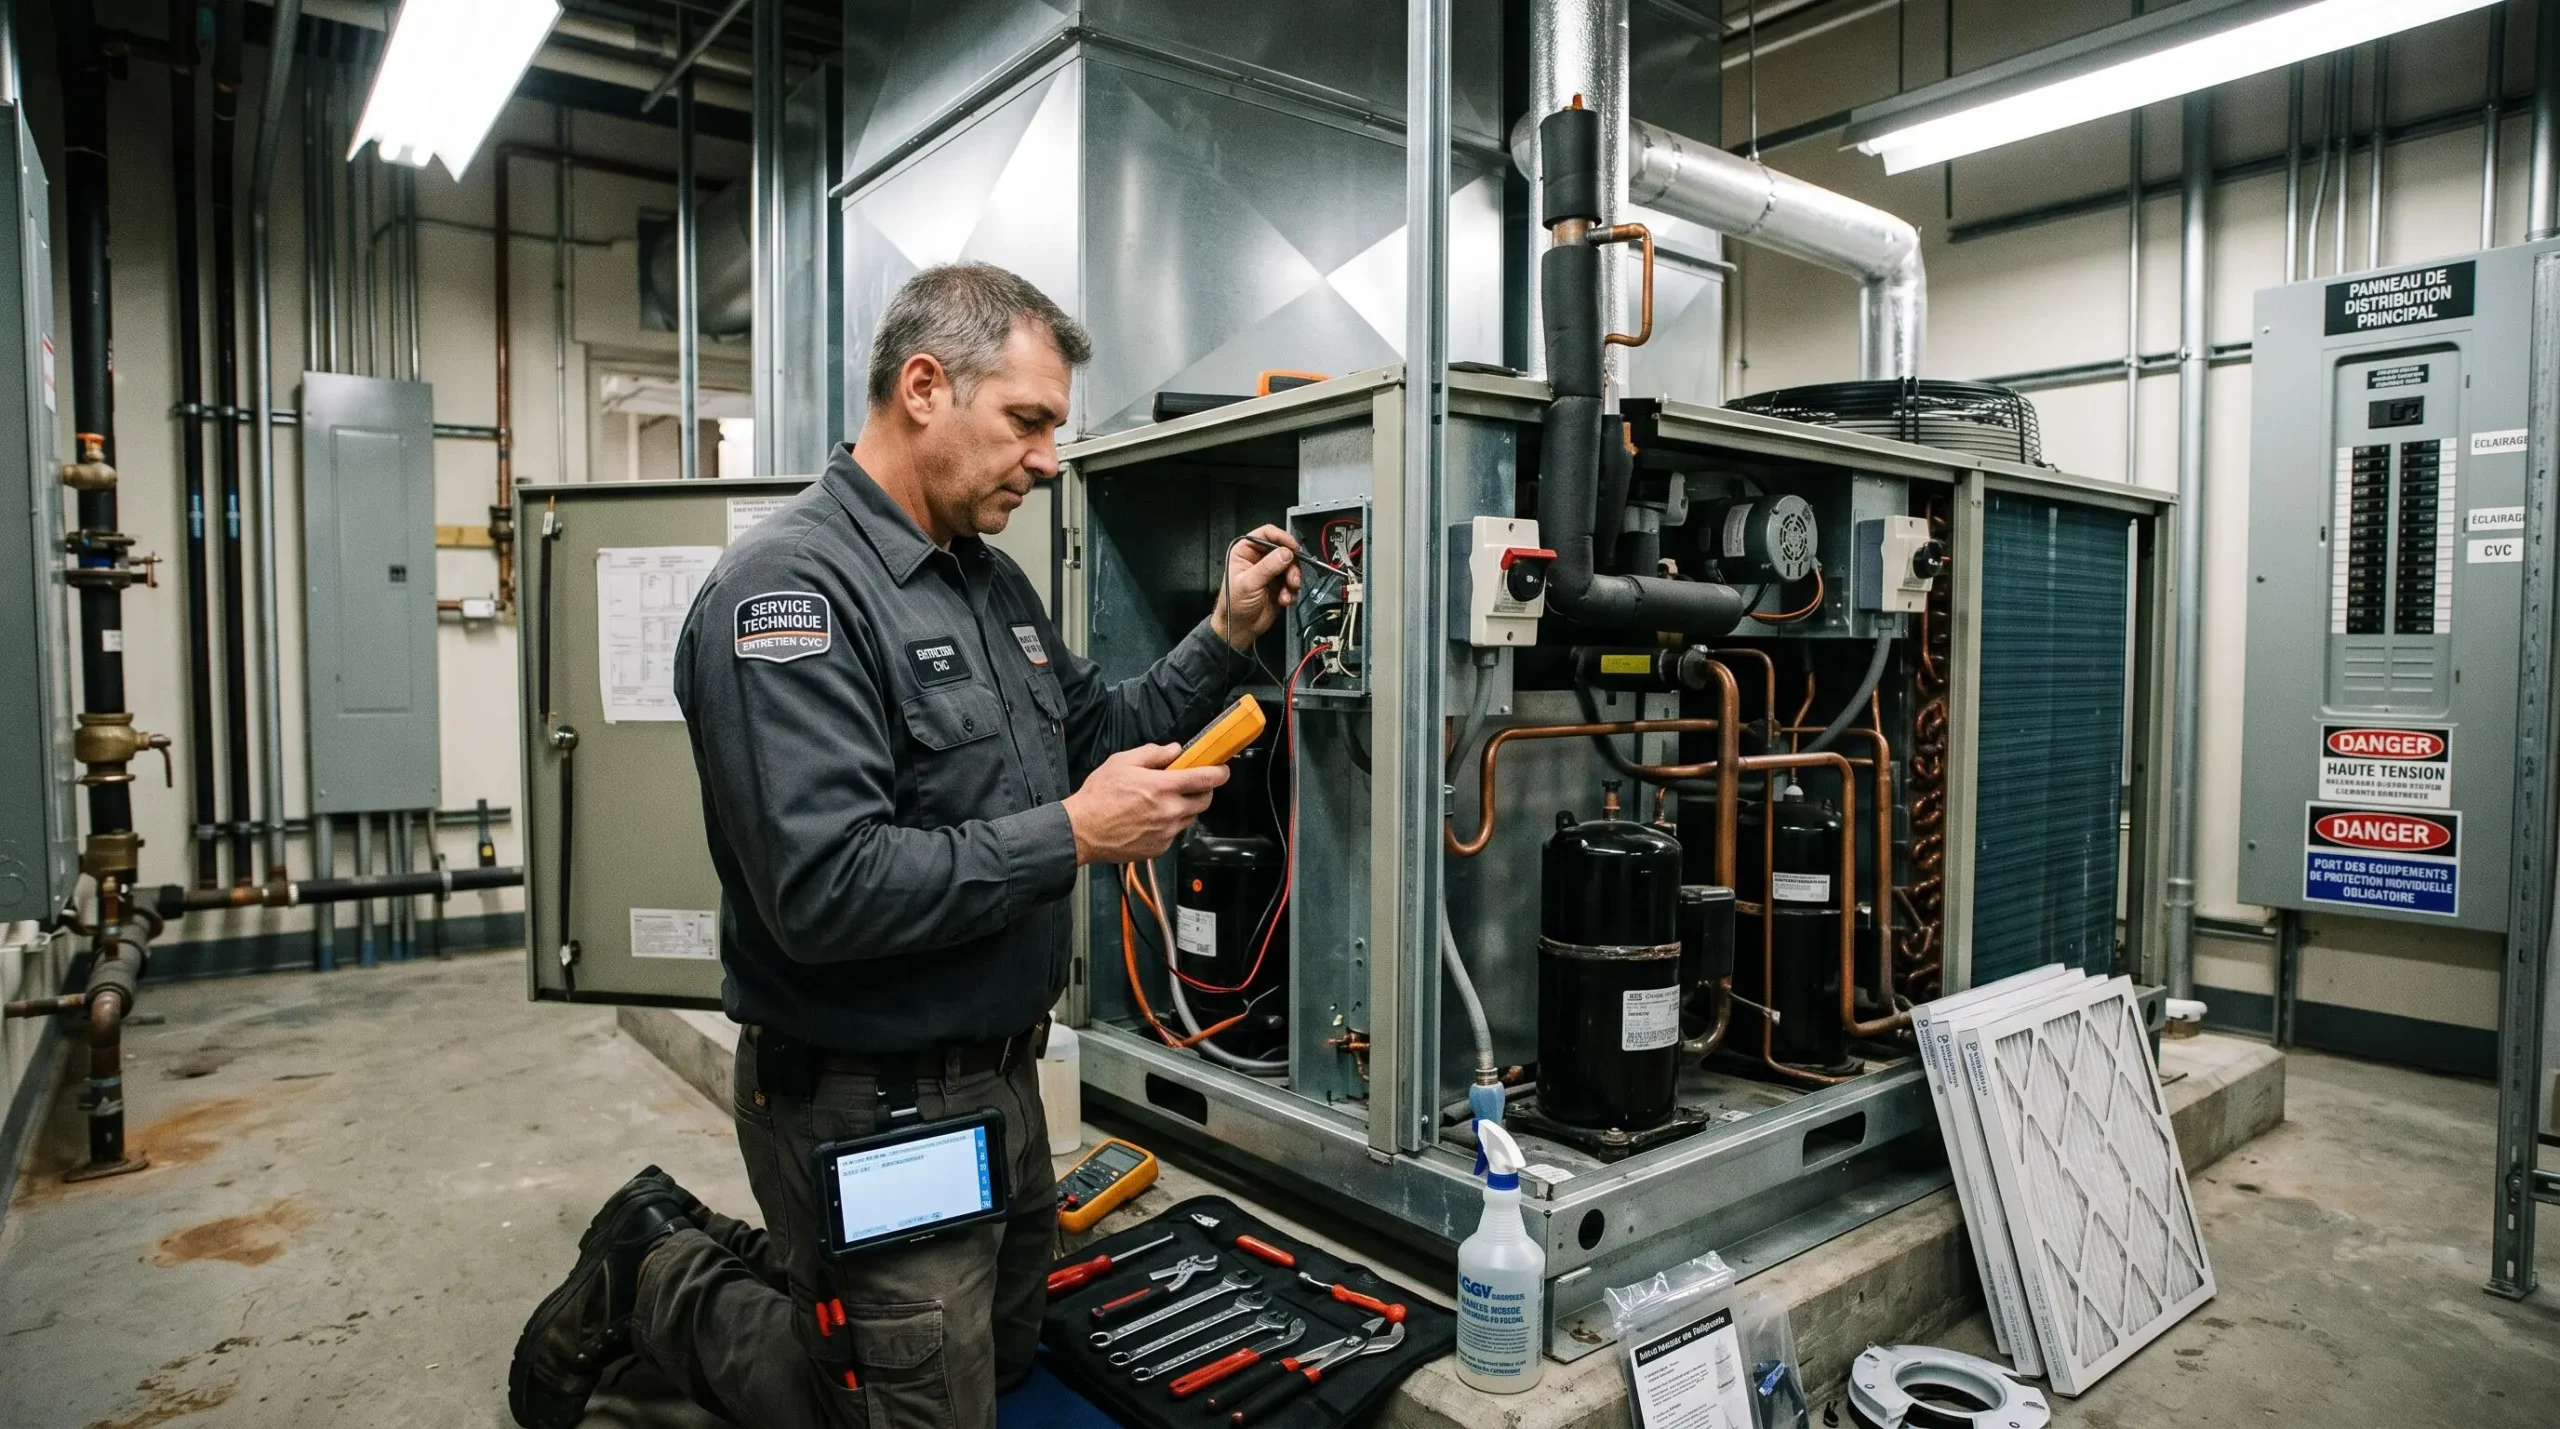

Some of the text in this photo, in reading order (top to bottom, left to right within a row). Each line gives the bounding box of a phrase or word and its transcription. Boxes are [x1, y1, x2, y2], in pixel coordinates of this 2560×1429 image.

[2349, 268, 2447, 298] PANNEAU DE
[2344, 284, 2452, 315] DISTRIBUTION
[2357, 304, 2438, 328] PRINCIPAL
[2484, 544, 2512, 557] CVC
[751, 600, 812, 617] SERVICE
[742, 614, 822, 633] TECHNIQUE
[799, 637, 823, 647] CVC
[2339, 734, 2432, 754] DANGER
[2327, 762, 2445, 781] HAUTE TENSION
[2333, 819, 2430, 845] DANGER
[2344, 860, 2366, 873] DES
[2309, 870, 2322, 881] DE
[2323, 871, 2383, 887] PROTECTION
[2342, 886, 2416, 904] OBLIGATOIRE
